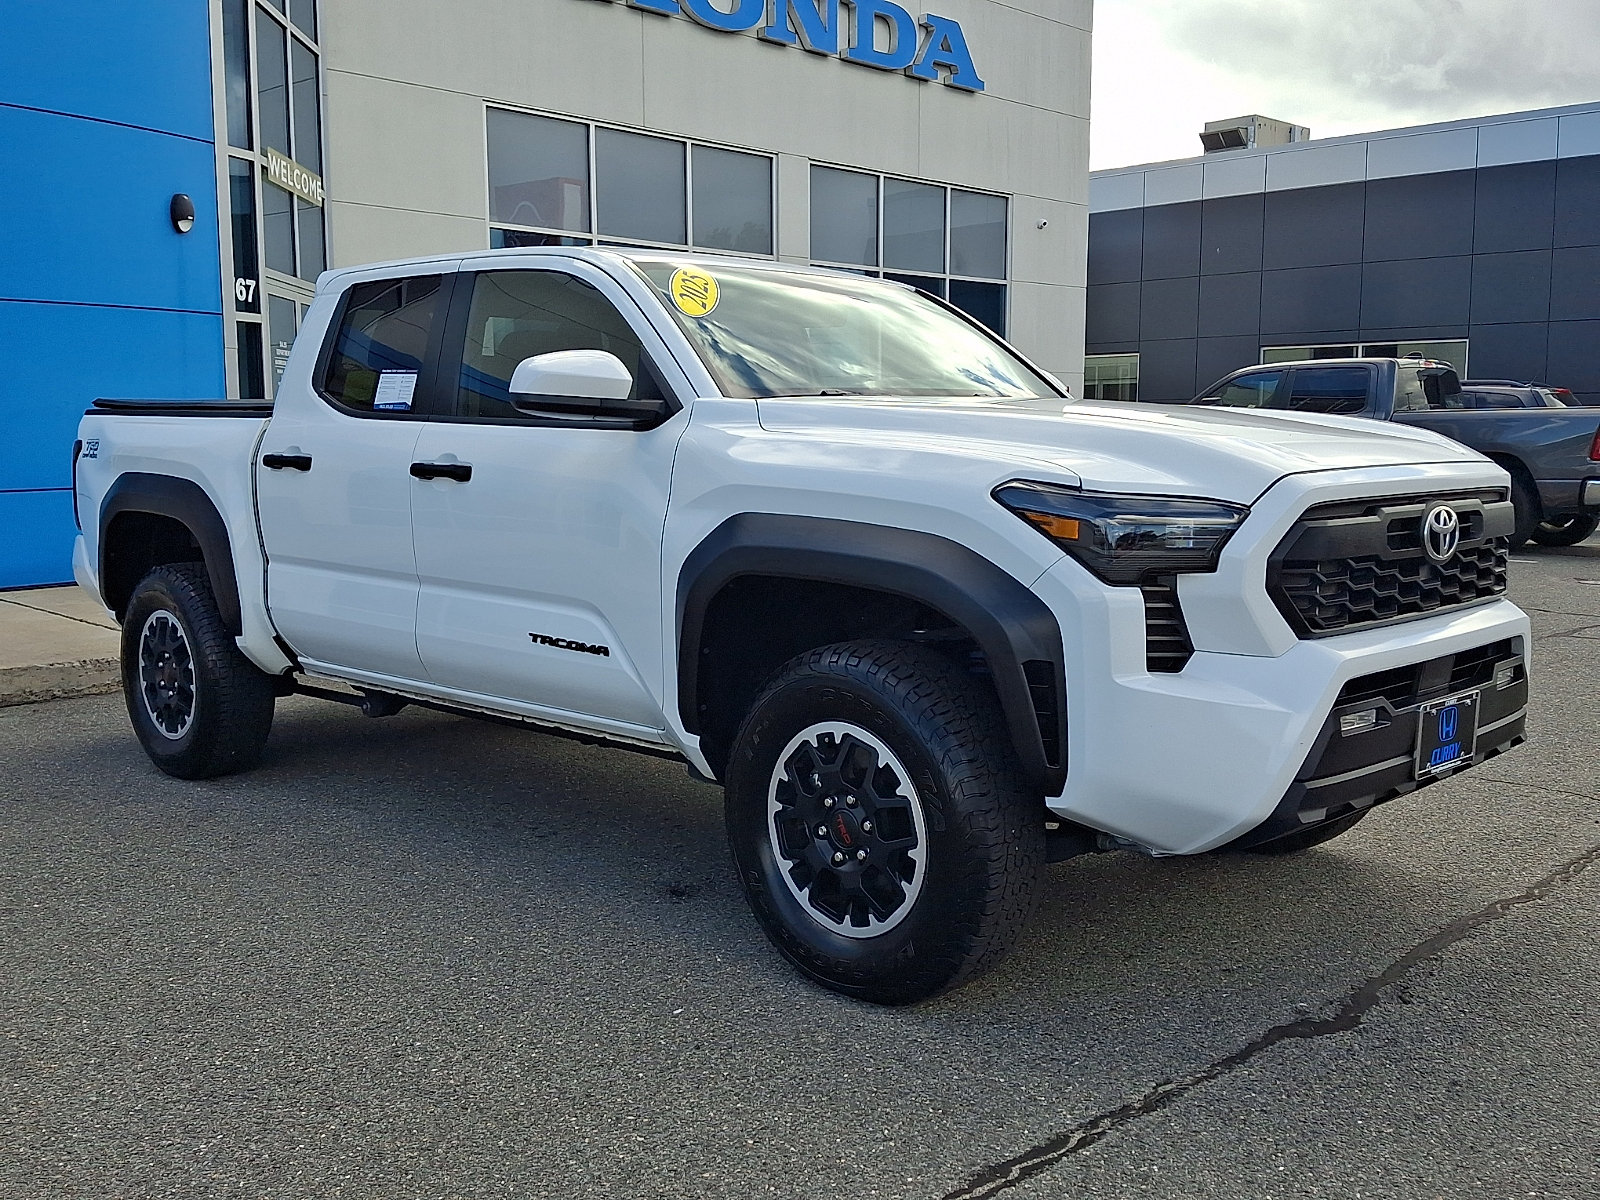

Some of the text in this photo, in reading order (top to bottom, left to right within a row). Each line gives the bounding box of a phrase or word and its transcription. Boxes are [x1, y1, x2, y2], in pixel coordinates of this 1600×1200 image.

[624, 0, 985, 92] NDA
[267, 152, 322, 201] WELCOME
[679, 270, 709, 310] 2025
[528, 632, 610, 657] TACOMA
[1431, 741, 1462, 766] CURRY
[836, 813, 852, 845] TRD
